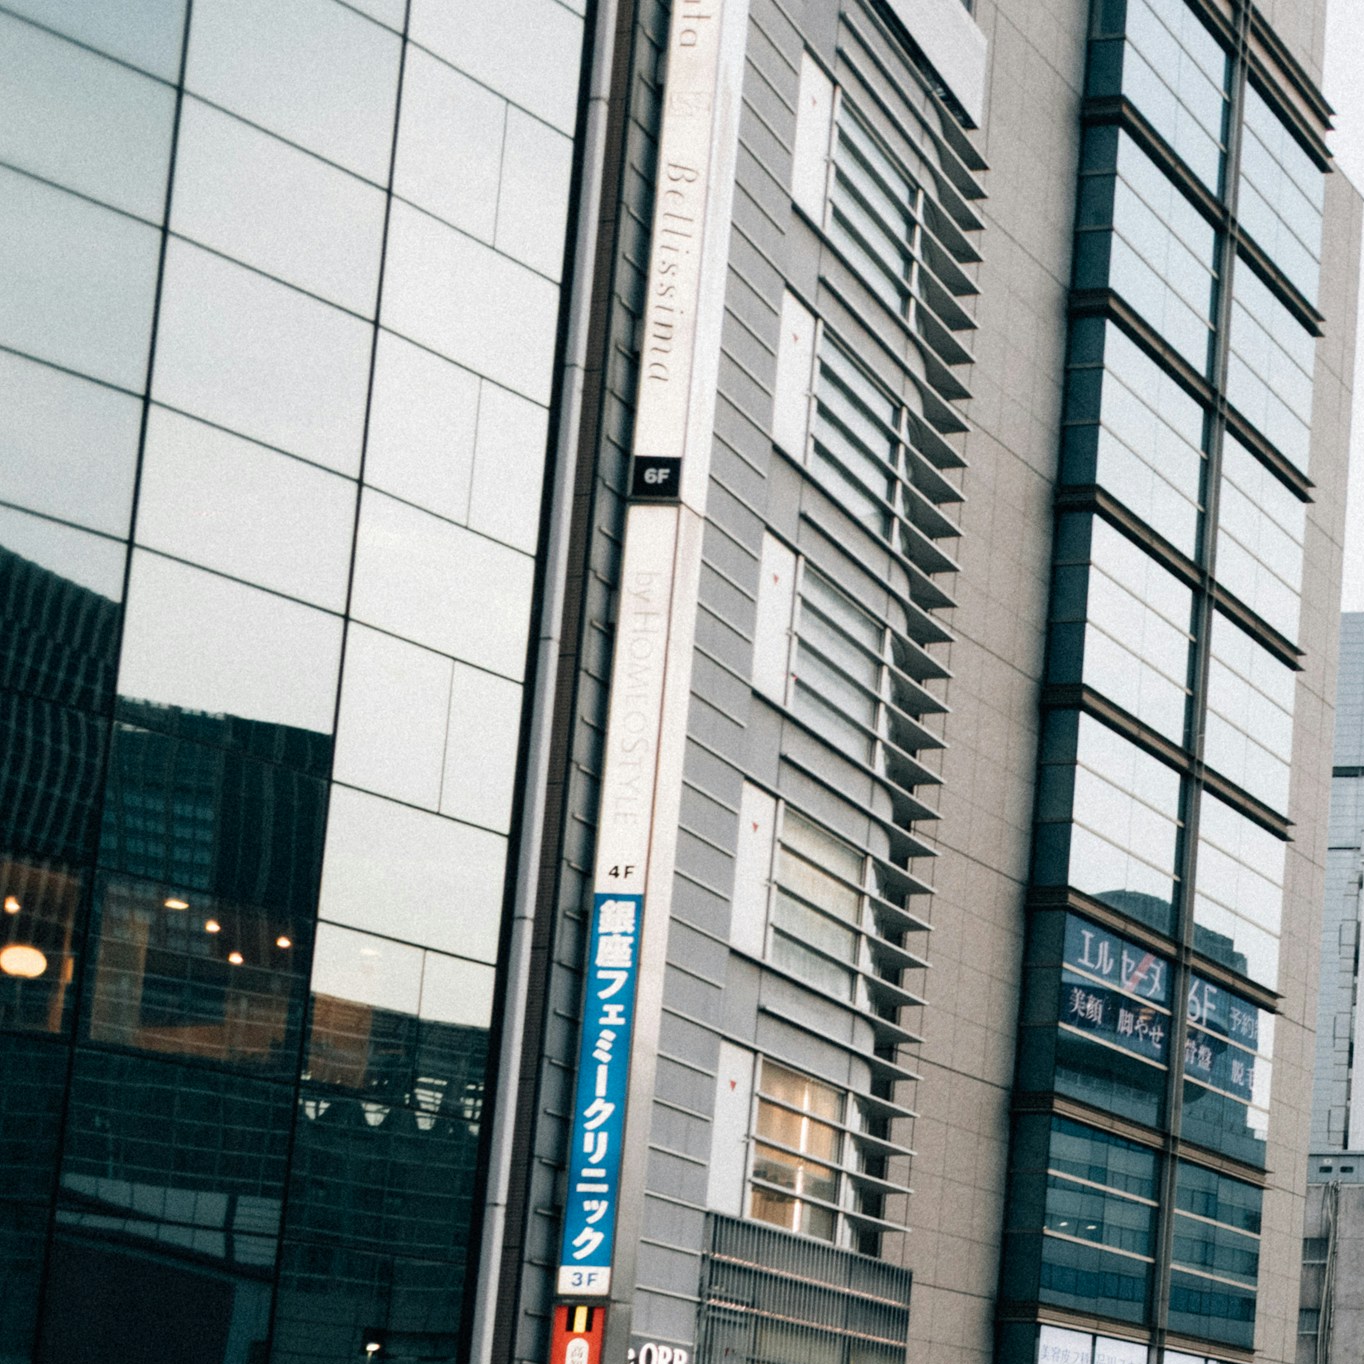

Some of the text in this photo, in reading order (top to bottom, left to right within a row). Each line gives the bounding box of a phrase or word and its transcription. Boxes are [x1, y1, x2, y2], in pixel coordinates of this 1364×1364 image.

[646, 161, 700, 384] Bellissima
[642, 466, 671, 487] 6F
[608, 865, 634, 879] 4F
[571, 899, 639, 1262] 銀座フェミークリニック
[570, 1271, 597, 1287] 3F
